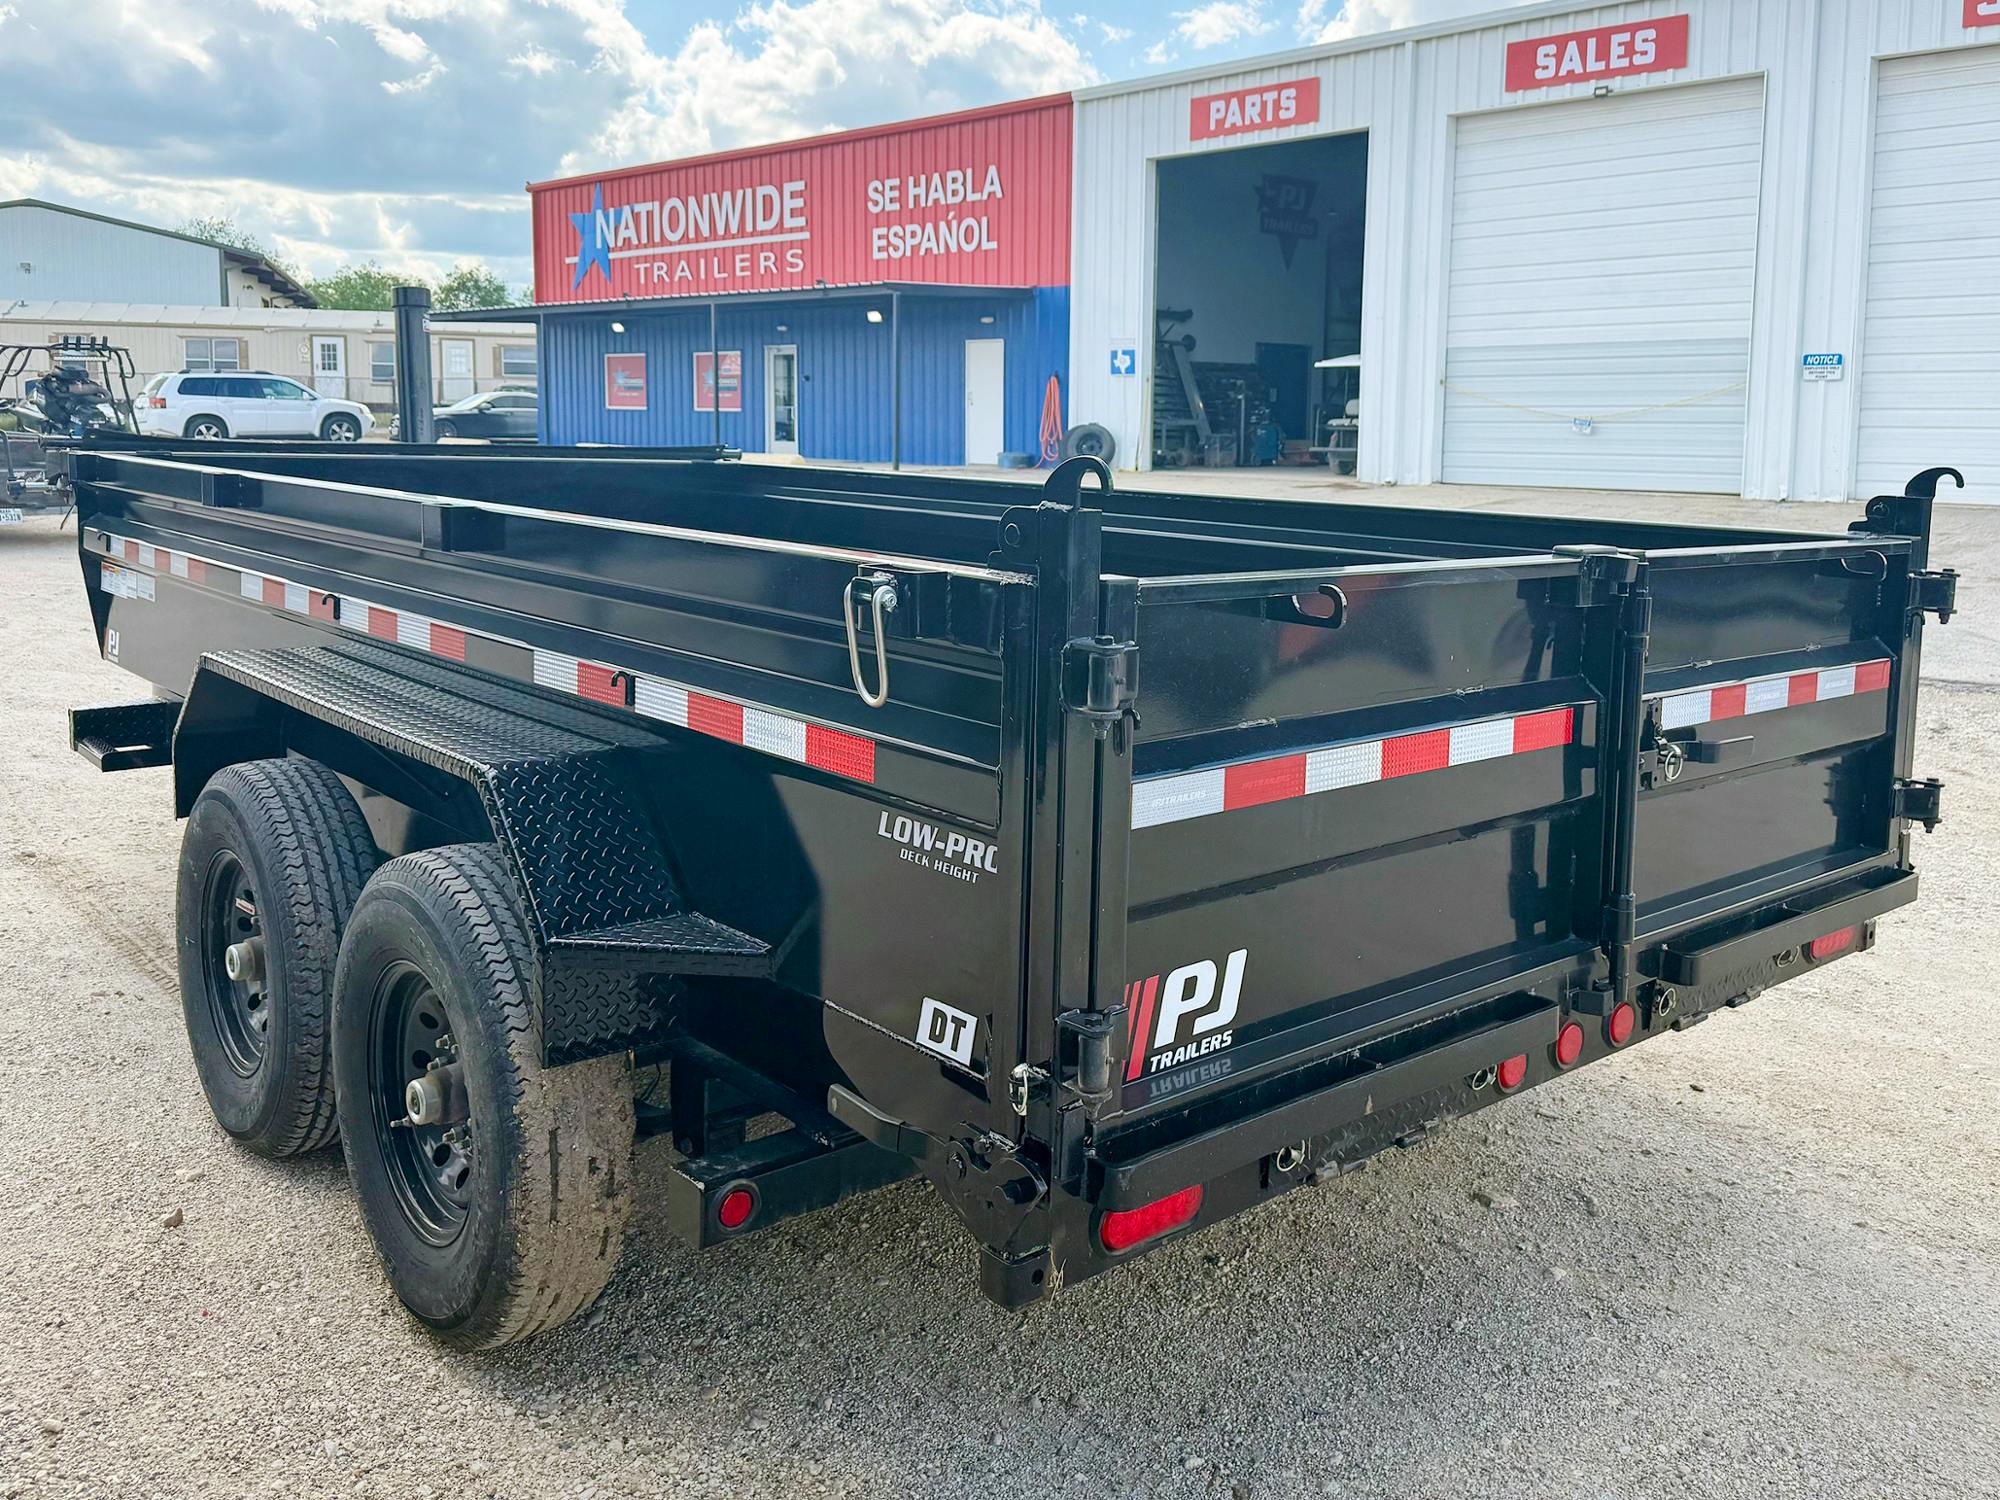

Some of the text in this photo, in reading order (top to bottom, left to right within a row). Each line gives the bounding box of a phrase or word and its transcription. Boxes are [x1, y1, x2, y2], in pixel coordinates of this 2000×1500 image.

[1534, 28, 1657, 80] SALES
[1209, 88, 1297, 131] PARTS
[867, 165, 1003, 214] SE HABLA
[595, 180, 807, 249] NATIONWIDE
[634, 249, 806, 284] TRAILERS
[1806, 355, 1839, 364] NOTICE
[108, 628, 120, 656] PJ
[900, 848, 979, 883] DECK HEIGHT
[1153, 948, 1248, 1049] PJ
[928, 1007, 967, 1052] DT
[1150, 1030, 1233, 1073] TRAILERS
